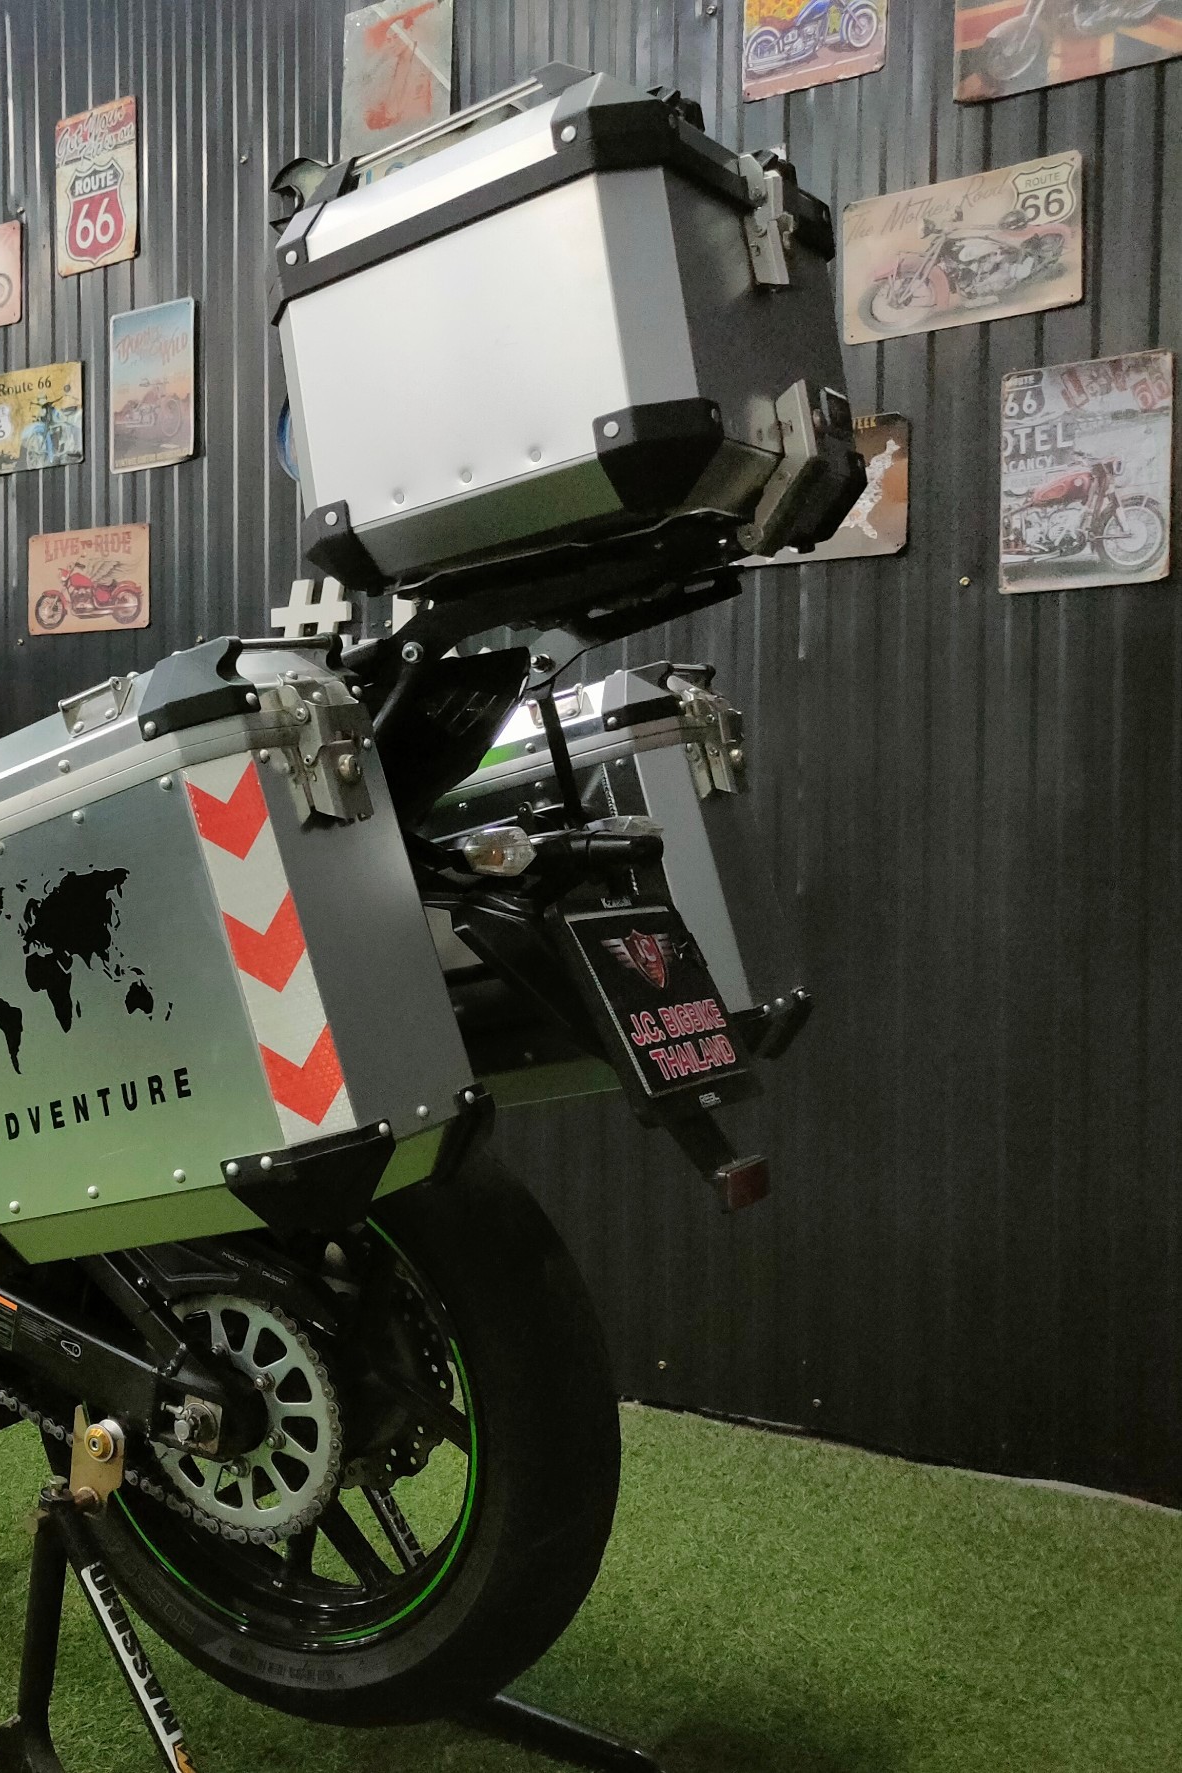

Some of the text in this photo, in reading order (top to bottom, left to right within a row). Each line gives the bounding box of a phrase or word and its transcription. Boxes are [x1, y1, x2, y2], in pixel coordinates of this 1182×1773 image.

[74, 170, 117, 197] ROUTE
[1024, 171, 1062, 189] ROUTE
[1021, 187, 1065, 223] 66
[75, 197, 115, 250] 66
[37, 375, 52, 389] 66
[1005, 390, 1038, 417] 66
[44, 537, 80, 563] LIVE
[94, 531, 132, 558] RIDE
[630, 998, 727, 1047] J.C. BIGBIKE
[649, 1033, 737, 1081] THAILAND
